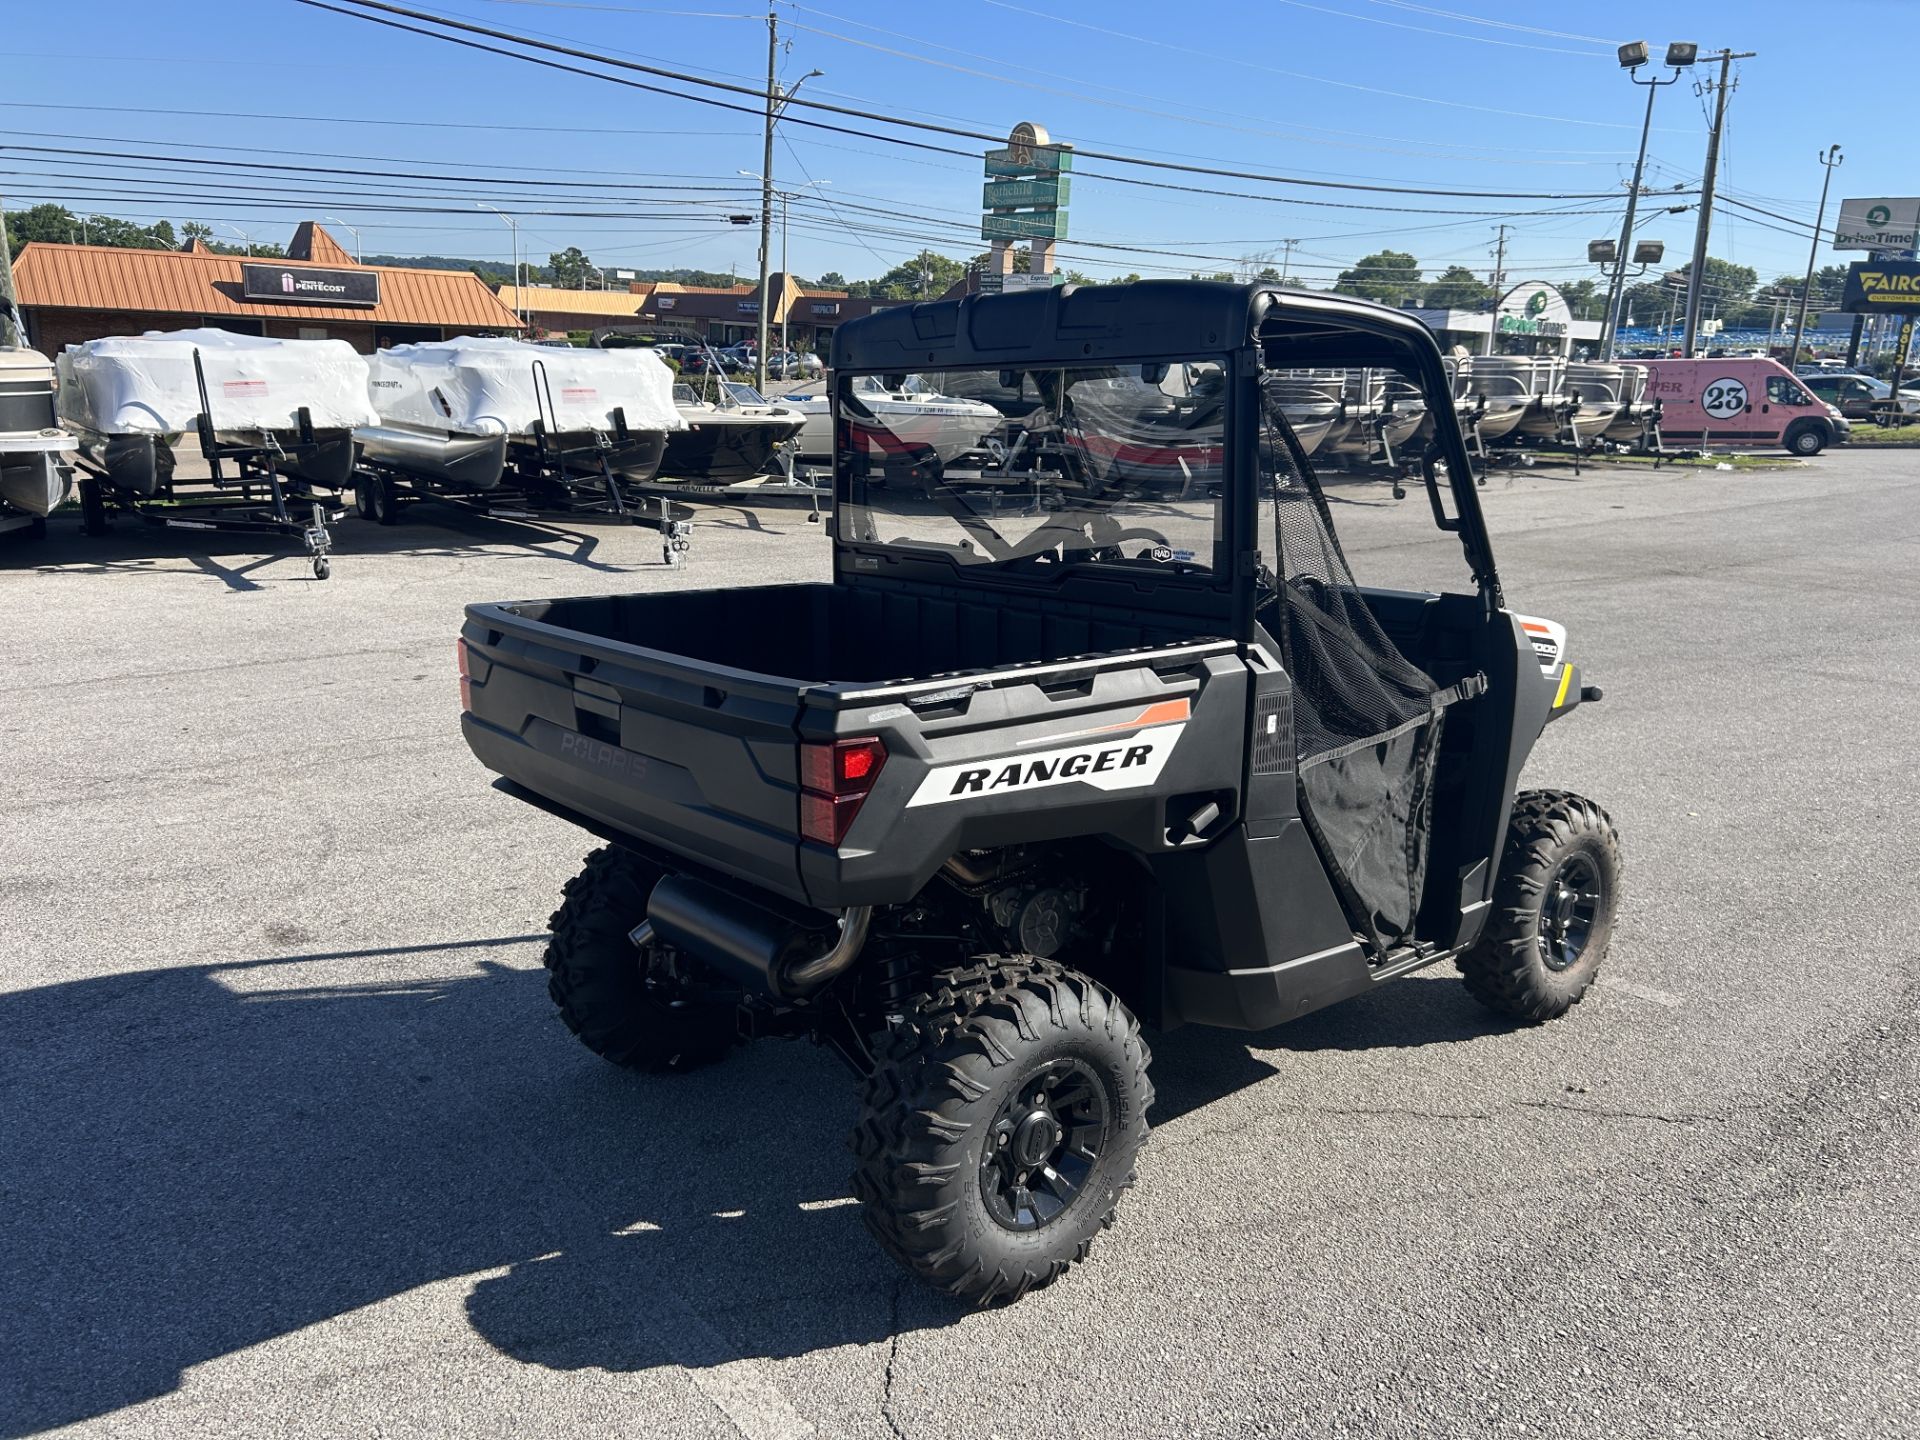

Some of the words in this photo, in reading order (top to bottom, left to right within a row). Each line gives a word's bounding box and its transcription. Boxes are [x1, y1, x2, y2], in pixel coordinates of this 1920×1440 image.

[1836, 232, 1912, 244] DriveTime
[1030, 274, 1049, 282] Express
[295, 283, 346, 293] PENTECOST
[1503, 315, 1568, 334] DriveTime
[1895, 323, 1911, 364] 8812
[1706, 387, 1744, 410] 23
[1154, 549, 1171, 558] RAD
[561, 733, 647, 779] POLARIS
[949, 744, 1154, 796] RANGER
